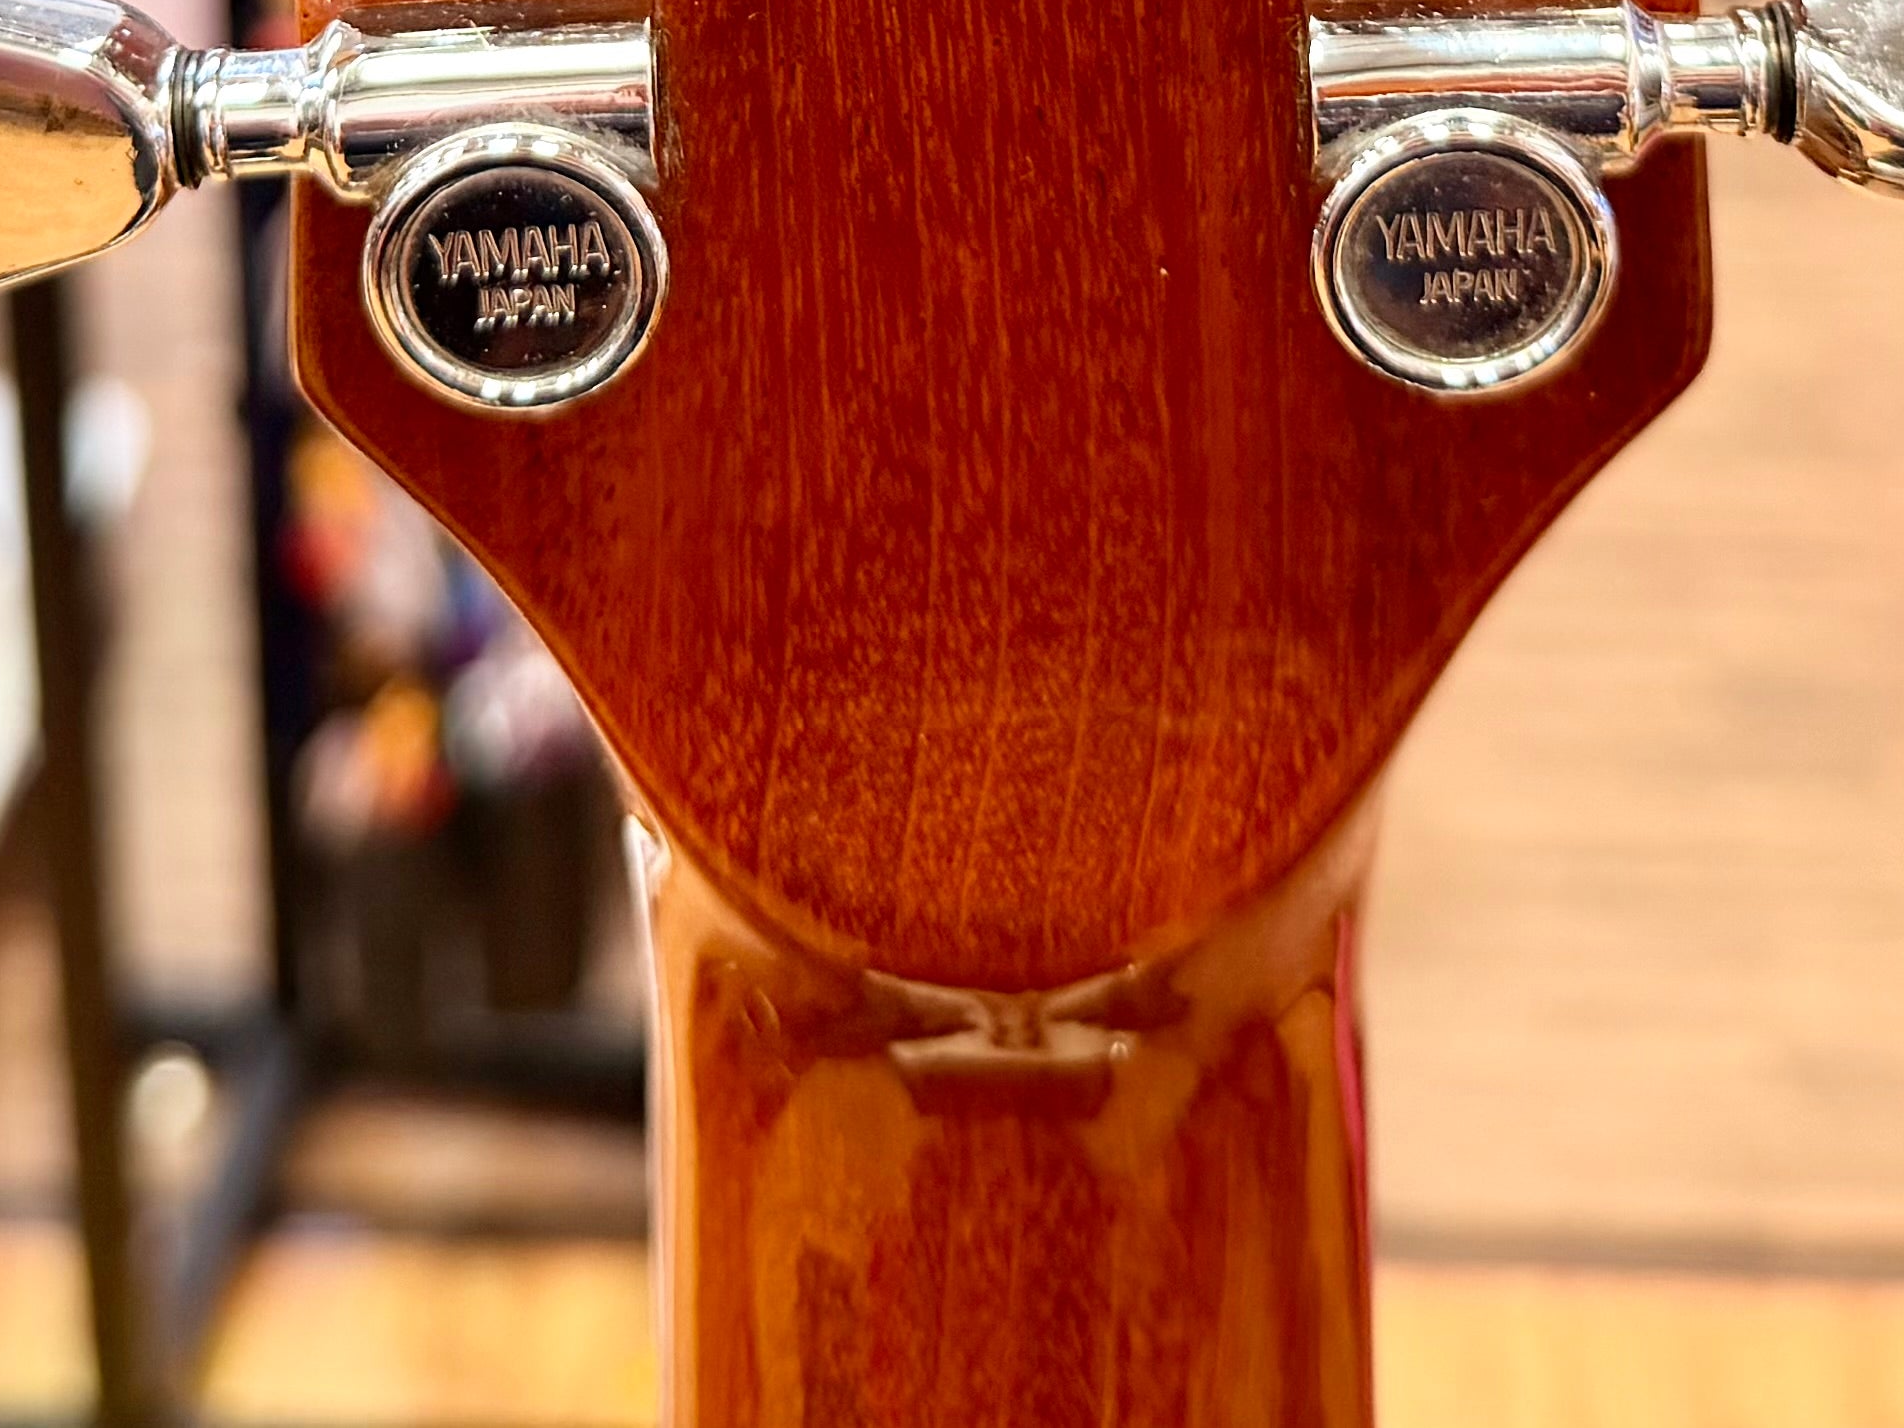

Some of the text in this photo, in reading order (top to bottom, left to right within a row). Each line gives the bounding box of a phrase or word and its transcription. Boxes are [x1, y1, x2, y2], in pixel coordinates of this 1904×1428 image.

[427, 221, 611, 285] YAMAHA
[1375, 205, 1560, 260] YAMAHA
[473, 282, 576, 330] JAPAN
[1419, 267, 1519, 304] JAPAN
